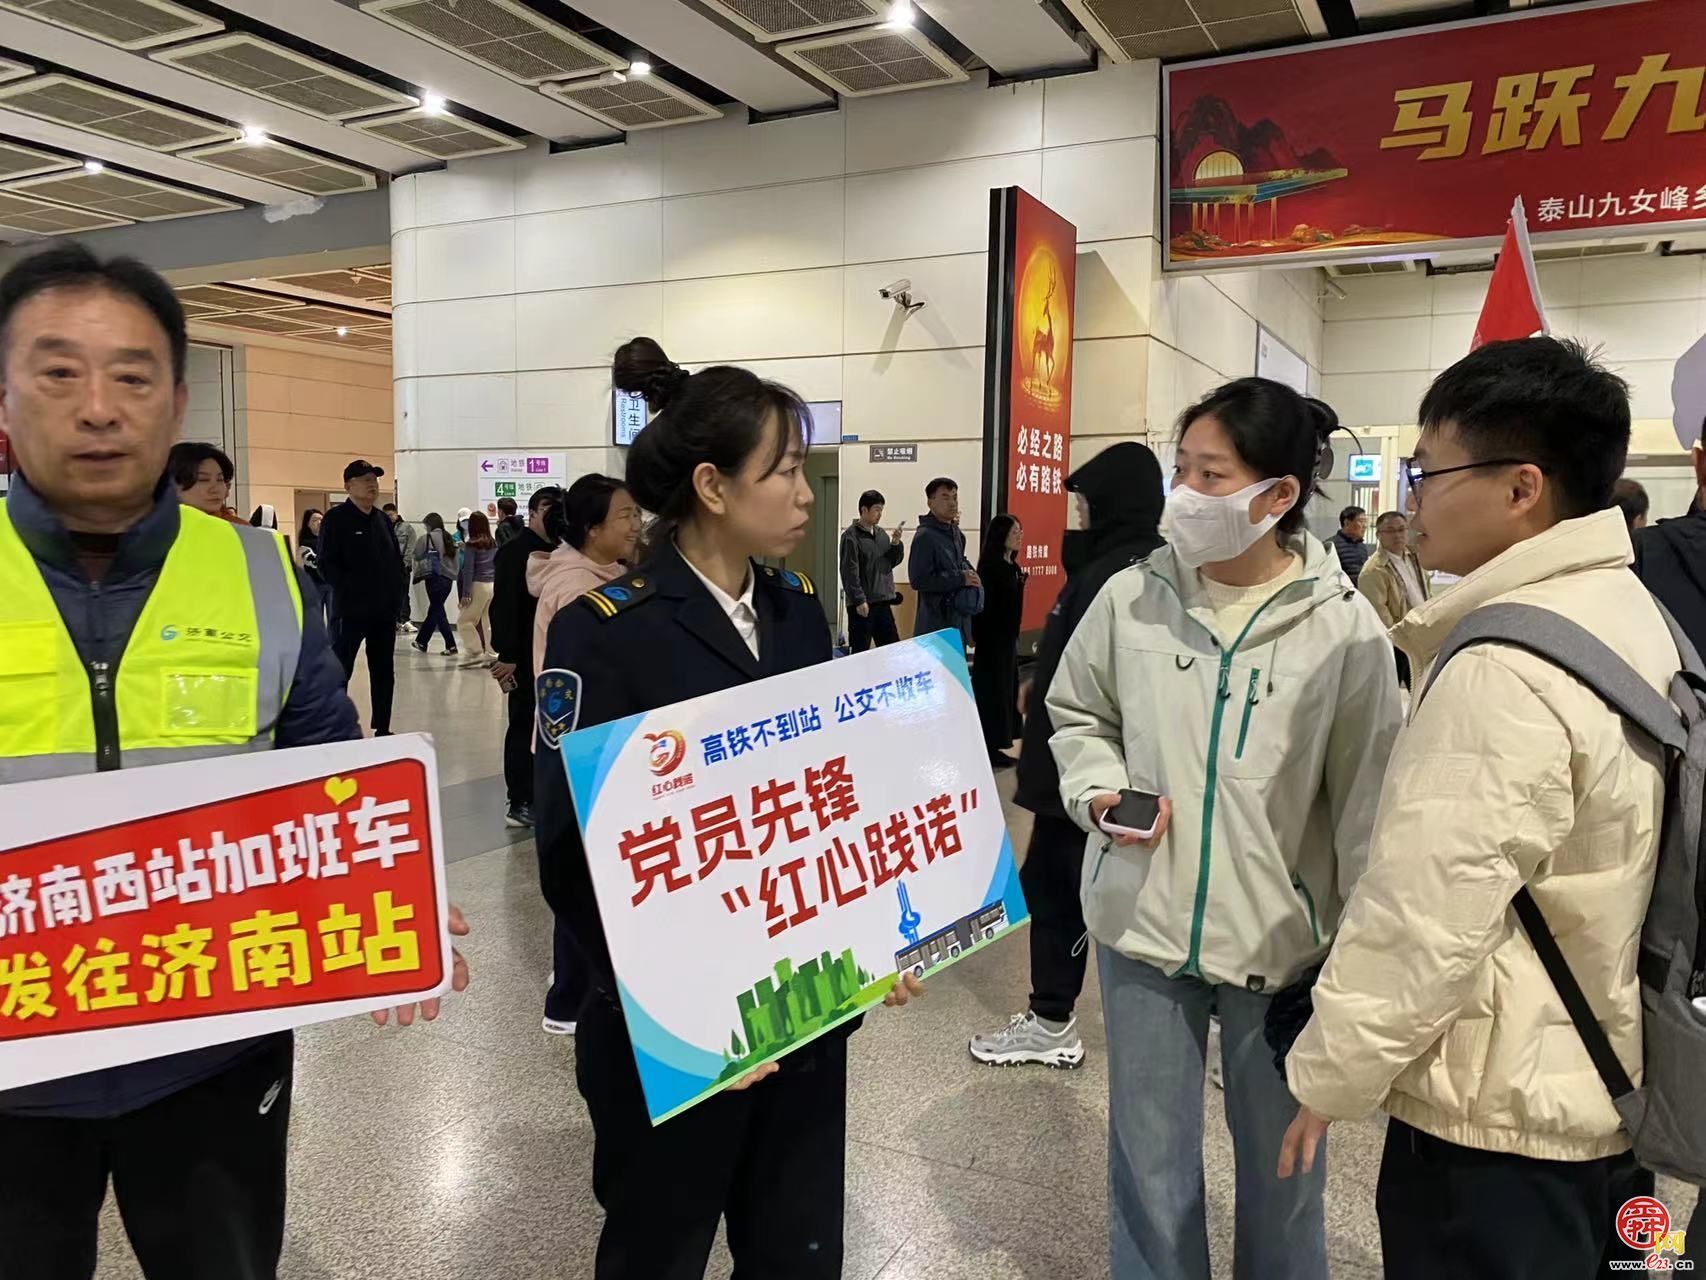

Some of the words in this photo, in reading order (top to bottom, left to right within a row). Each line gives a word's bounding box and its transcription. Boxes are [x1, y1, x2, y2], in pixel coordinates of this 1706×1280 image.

[1379, 53, 1706, 161] 马跃九
[628, 399, 640, 440] 卫生间
[887, 447, 913, 455] 禁止吸烟
[1017, 424, 1063, 461] 必经之路
[1016, 461, 1062, 494] 必有路铁
[700, 703, 821, 766] 高铁不到站
[834, 671, 935, 723] 公交不收车
[0, 796, 420, 938] 济南西站加班车
[618, 754, 861, 907] 党员先锋
[0, 890, 420, 1020] 发往济南站
